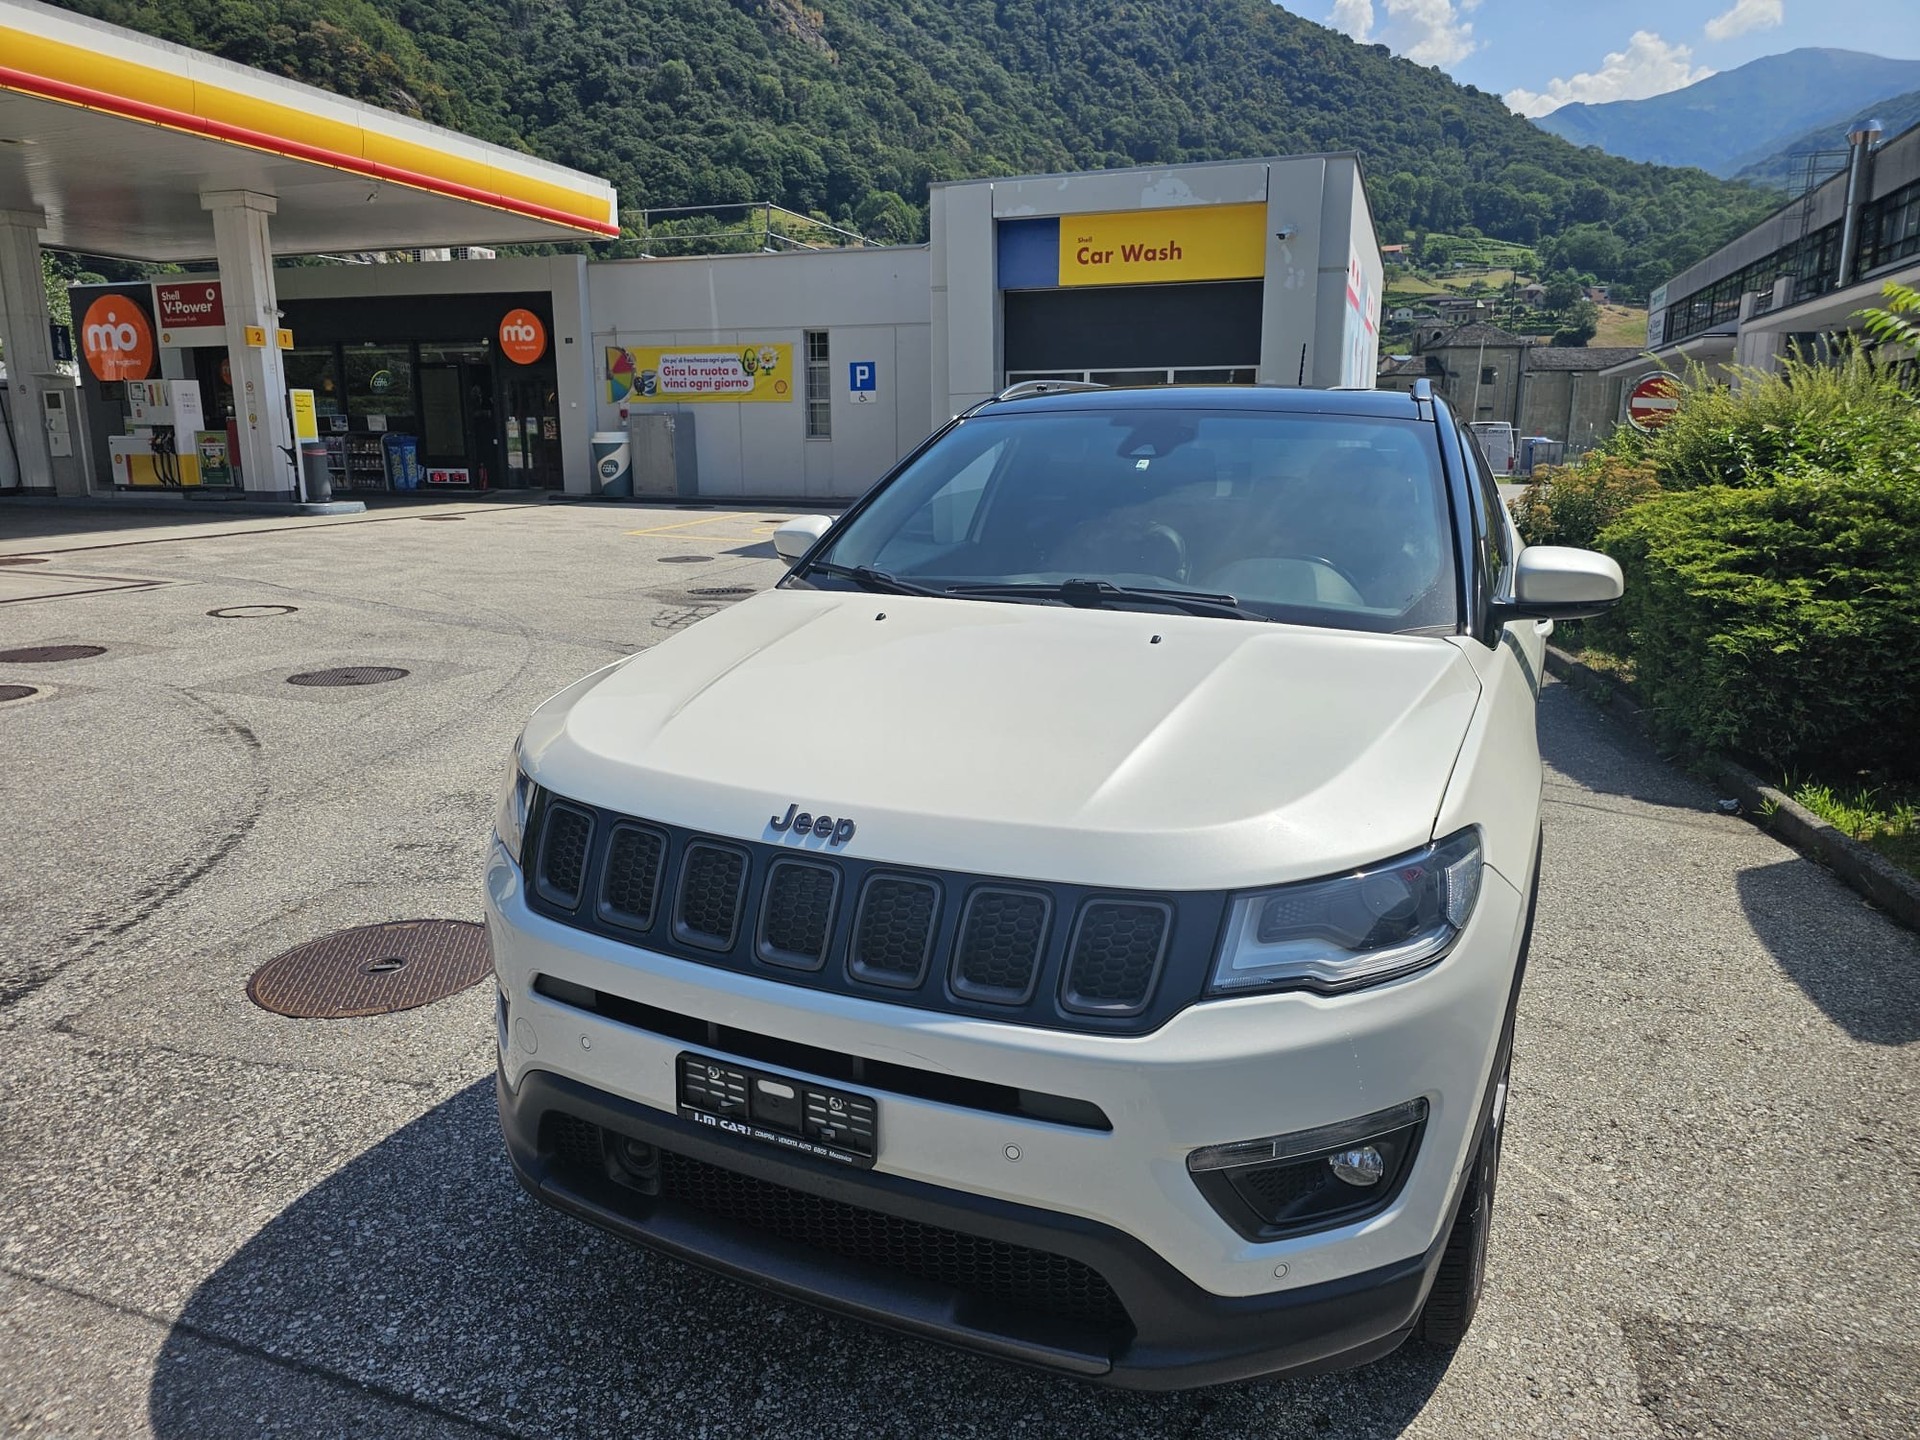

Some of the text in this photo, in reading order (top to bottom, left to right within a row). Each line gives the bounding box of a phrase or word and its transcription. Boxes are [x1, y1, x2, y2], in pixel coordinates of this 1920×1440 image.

[1077, 236, 1093, 244] Shell
[1076, 240, 1182, 266] Car Wash
[161, 290, 180, 301] Shell
[163, 301, 213, 315] V-Power
[87, 311, 138, 352] mio
[254, 331, 262, 342] 2
[502, 318, 535, 342] mio
[282, 333, 288, 343] 1
[663, 365, 738, 376] Gira la ruota e
[856, 366, 869, 388] P
[663, 377, 749, 390] vinci ogni giorno
[770, 803, 857, 847] Jeep
[754, 1130, 775, 1141] COMPRA
[798, 1142, 812, 1151] AUTO
